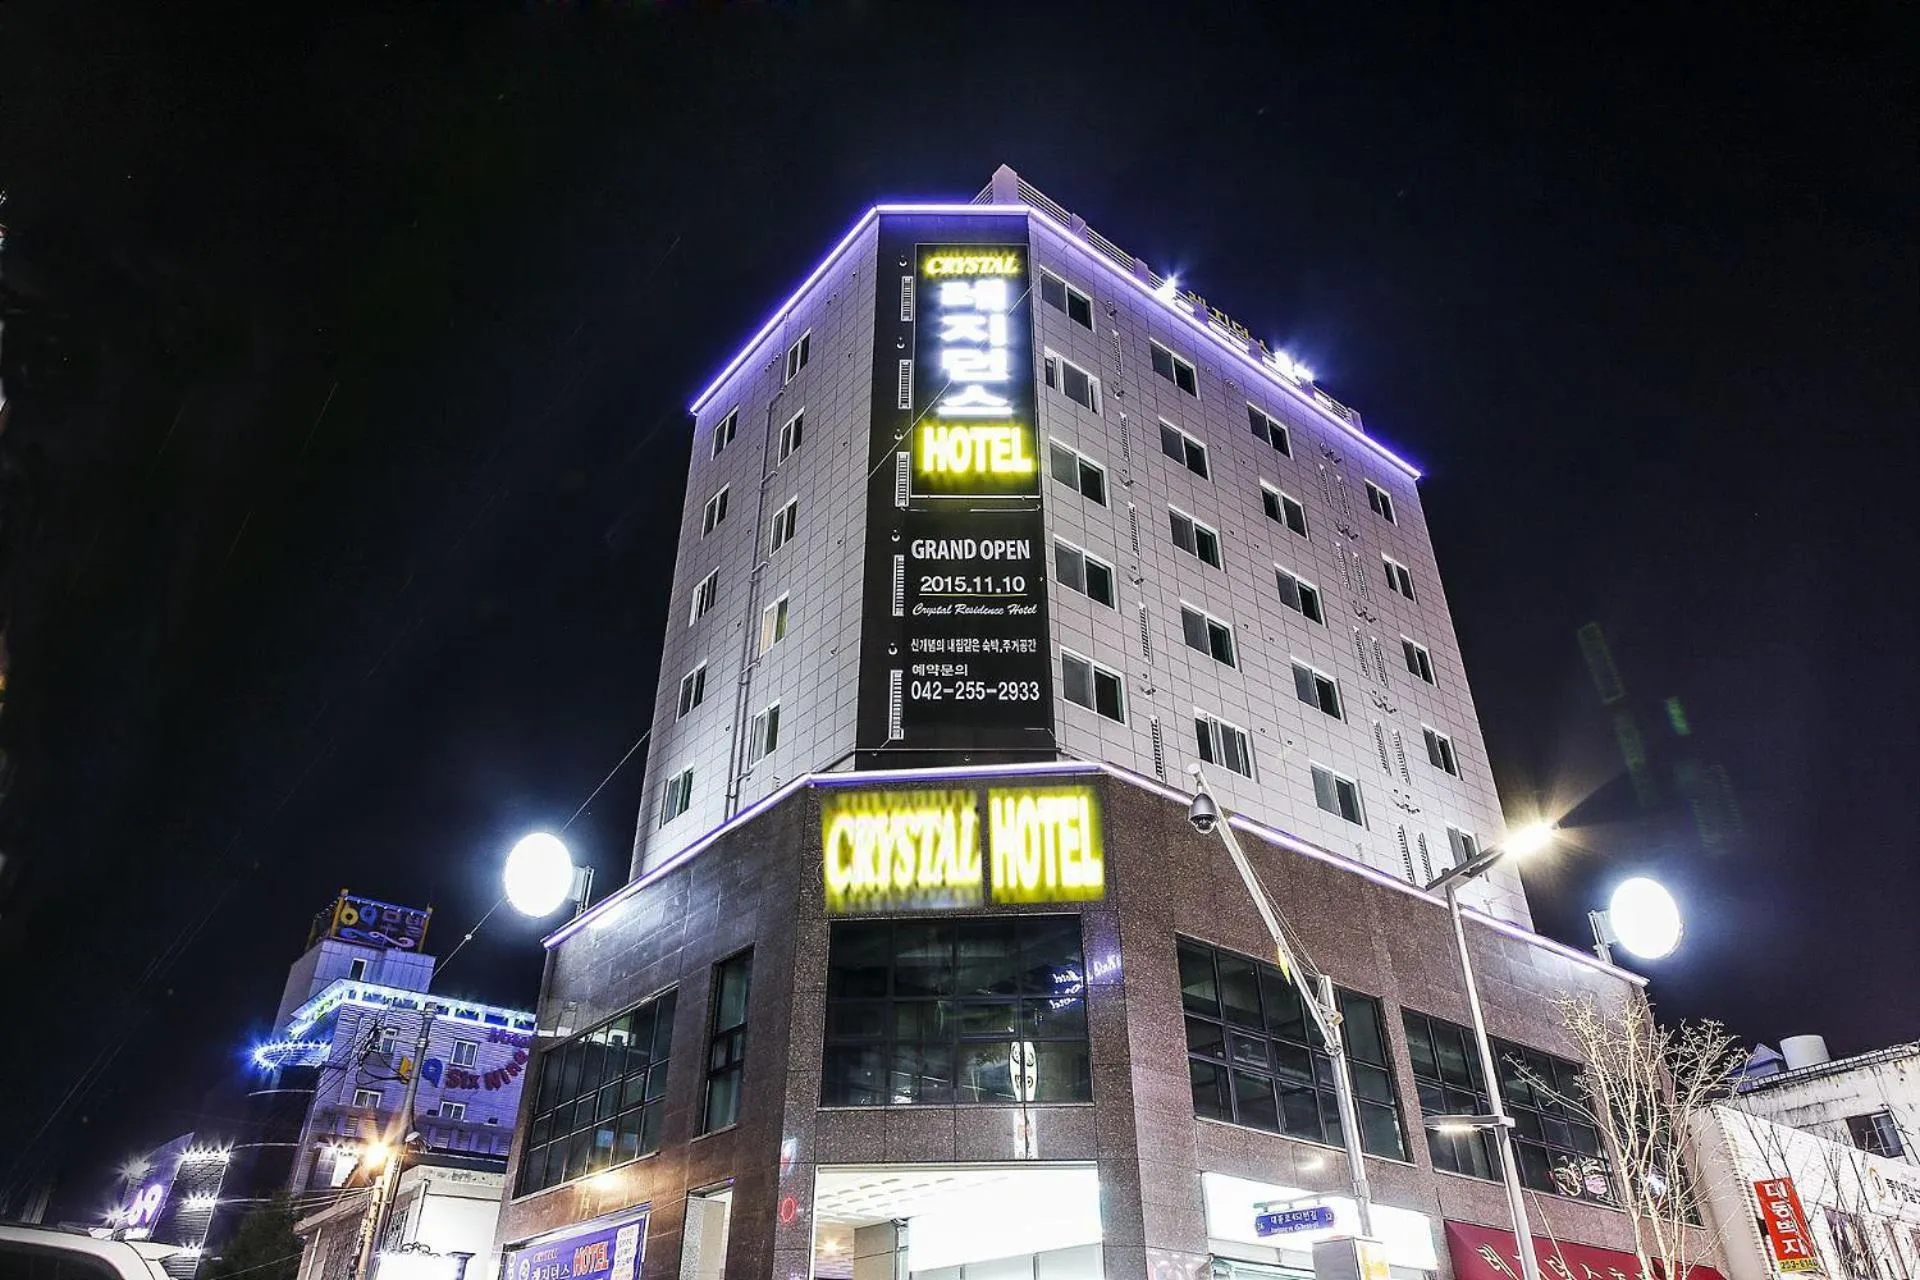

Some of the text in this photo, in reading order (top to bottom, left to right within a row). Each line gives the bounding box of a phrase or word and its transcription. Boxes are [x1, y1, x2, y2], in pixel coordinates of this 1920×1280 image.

[925, 255, 1020, 275] CRYSTAL
[922, 425, 1034, 473] HOTEL
[911, 539, 1031, 560] GRAND OPEN
[919, 576, 1026, 593] 2015.11.10
[912, 602, 1038, 617] Crystal Residence Hotel
[910, 638, 1037, 654] 신개념의 내집같은 숙박,주거공간
[912, 663, 969, 677] 예약문의
[911, 680, 1040, 701] 042-255-2933
[827, 795, 1104, 892] CRYSTAL HOTEL
